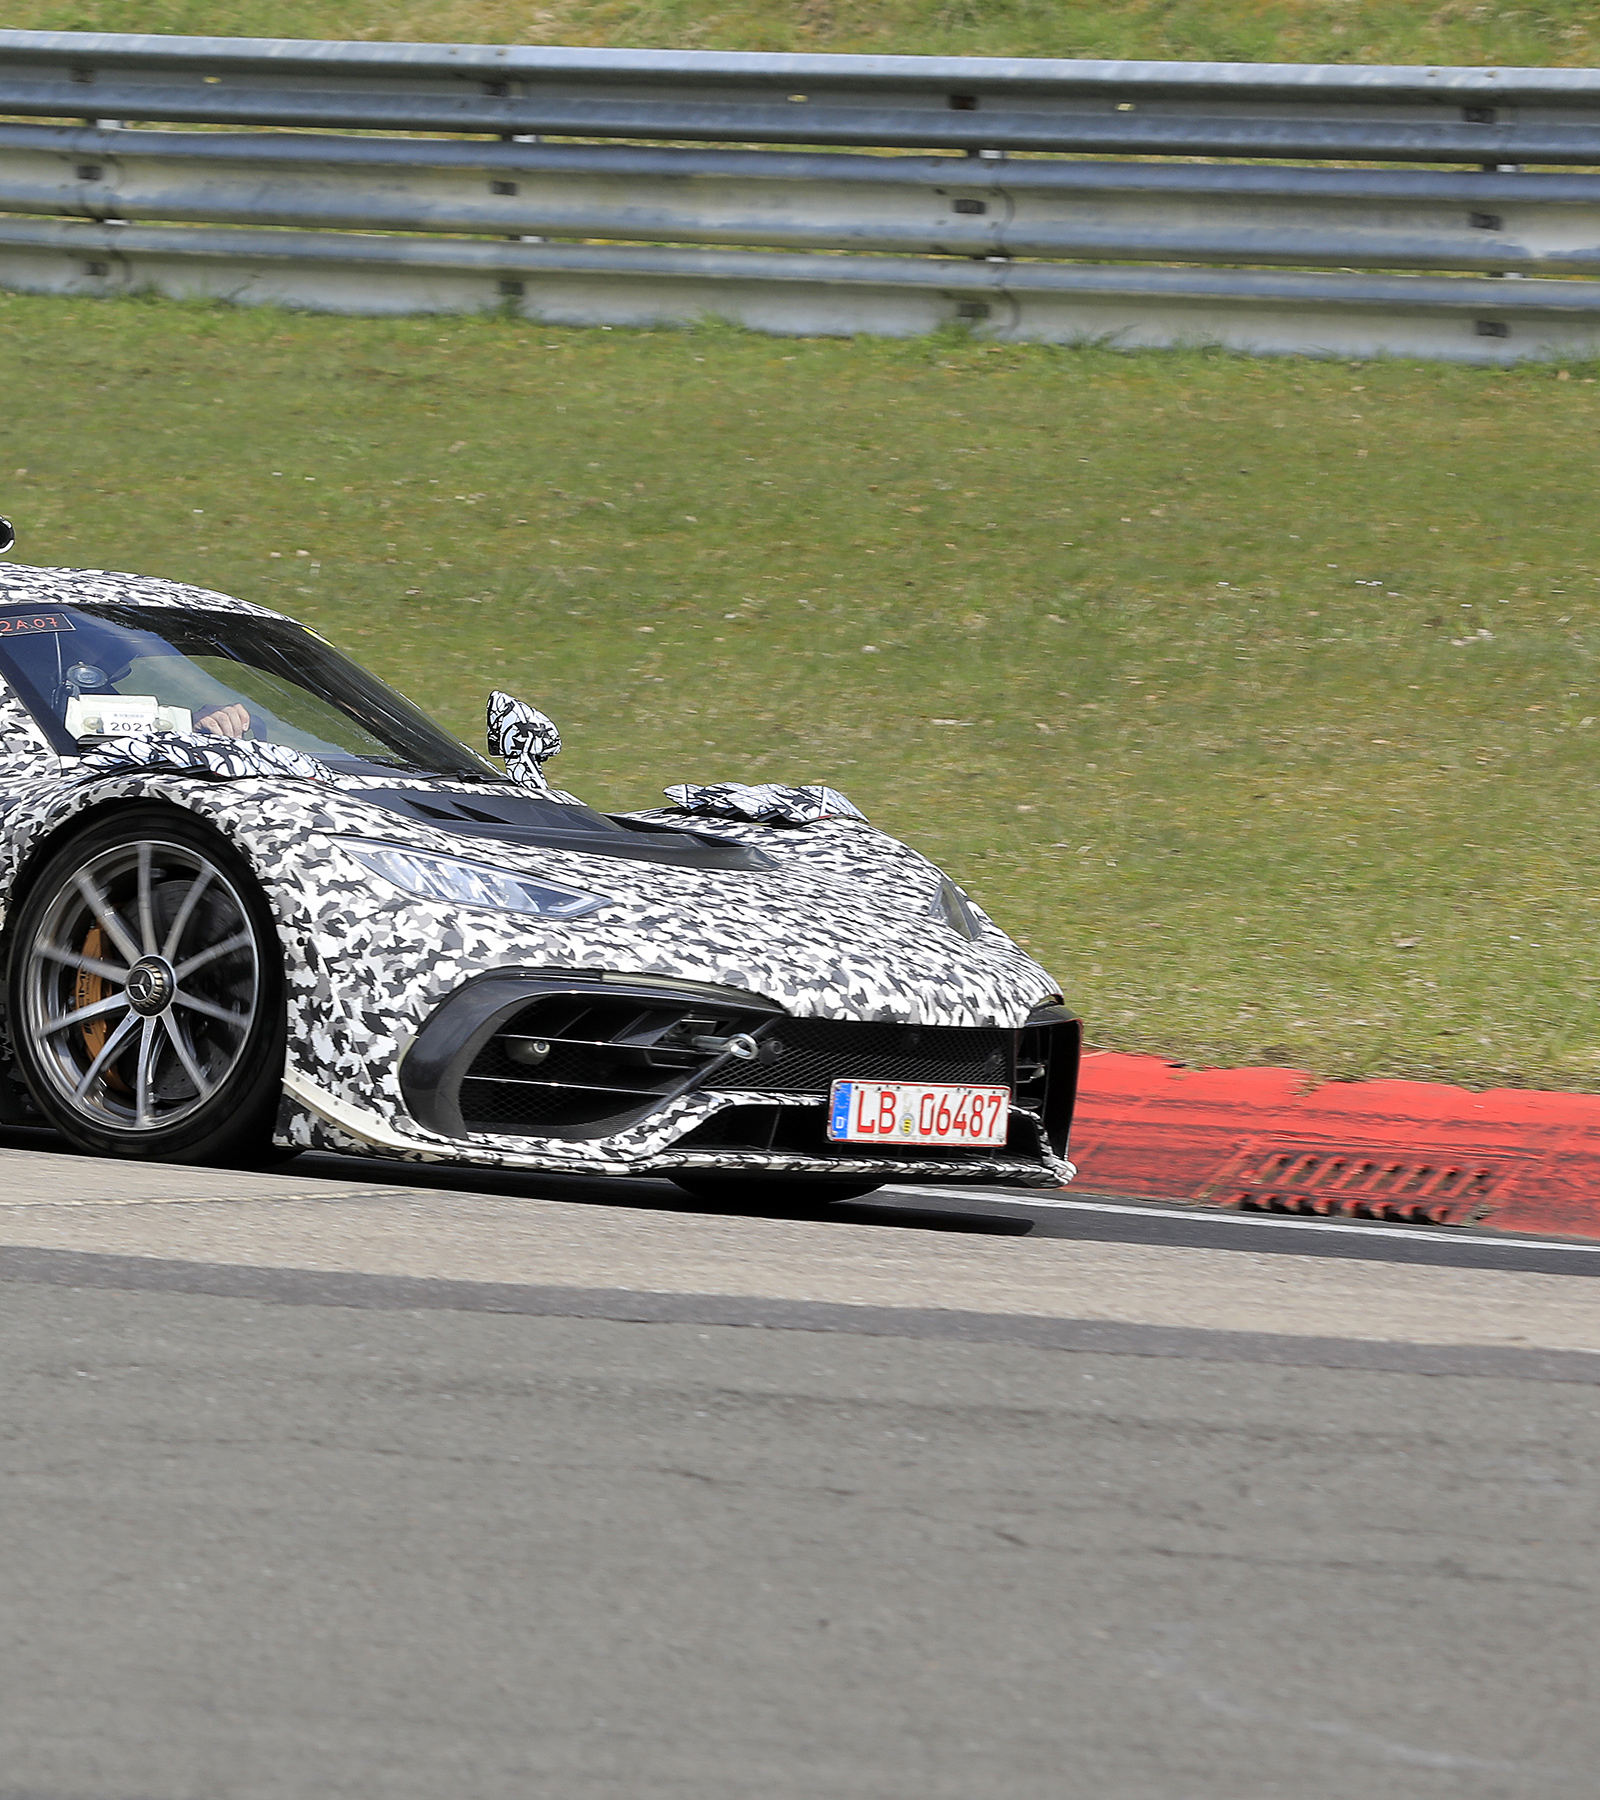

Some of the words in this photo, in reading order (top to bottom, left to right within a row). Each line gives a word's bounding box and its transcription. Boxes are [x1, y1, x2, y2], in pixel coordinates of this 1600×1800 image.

[110, 721, 153, 732] 2021
[835, 1116, 845, 1129] D
[857, 1090, 897, 1134] LB
[919, 1093, 1002, 1138] 06487
